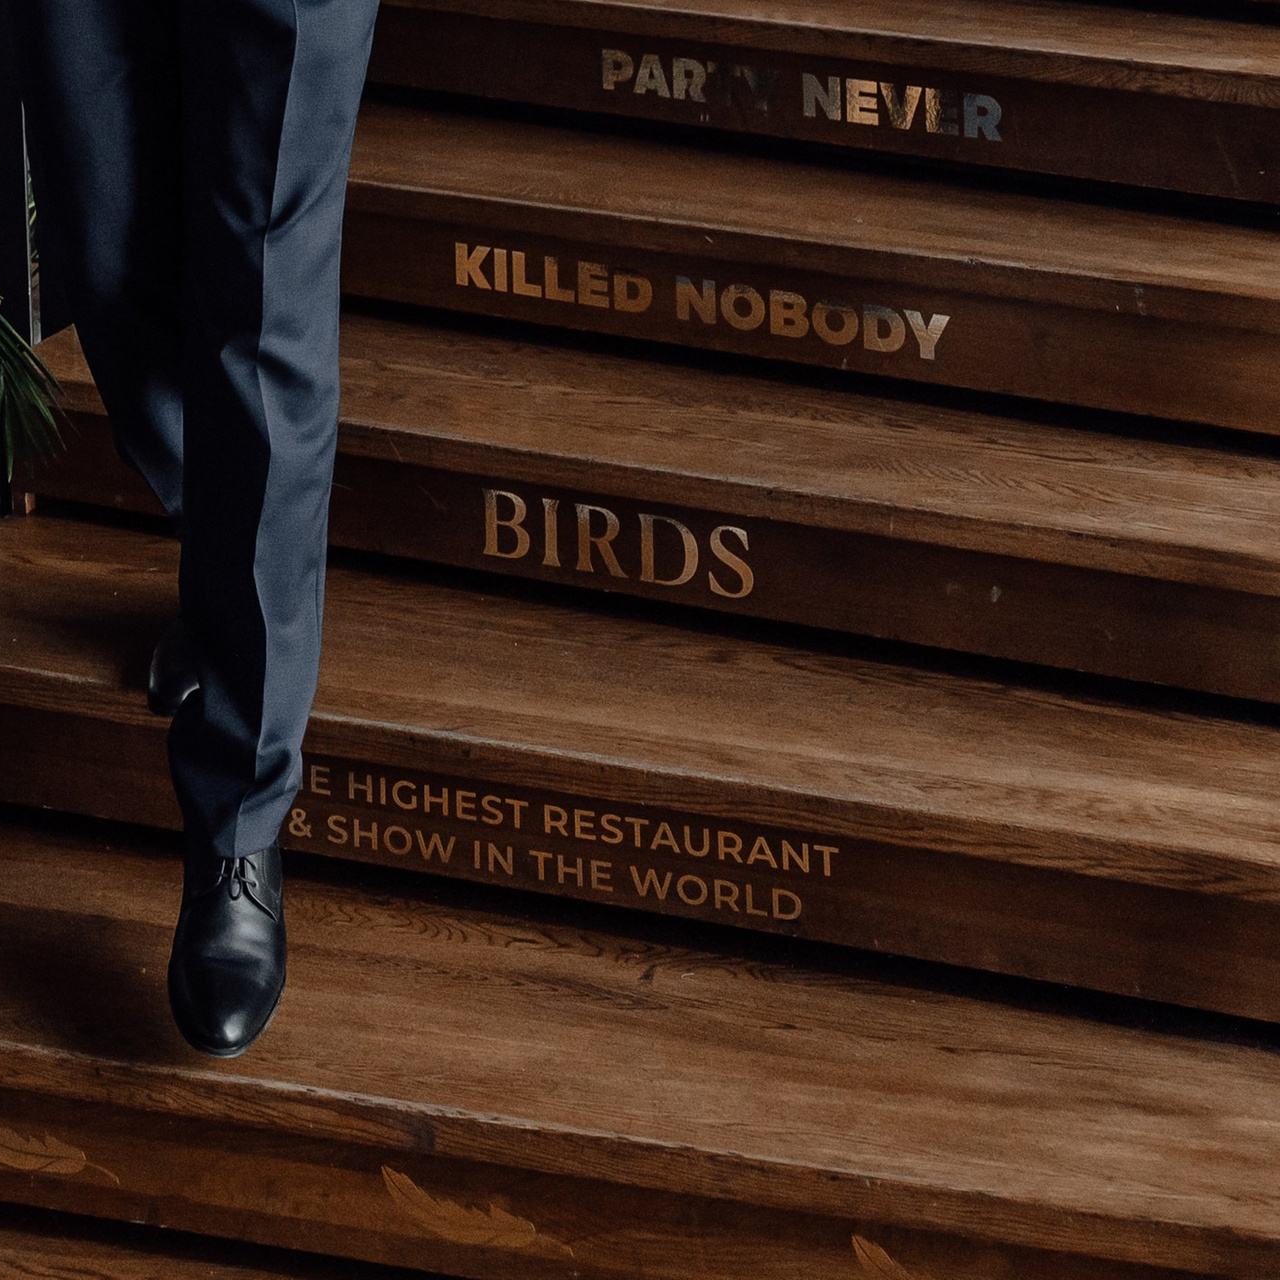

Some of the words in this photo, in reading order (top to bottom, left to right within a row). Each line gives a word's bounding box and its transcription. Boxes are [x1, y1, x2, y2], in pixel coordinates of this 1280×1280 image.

[801, 72, 1004, 142] NEVER
[454, 241, 654, 314] KILLED
[674, 274, 952, 361] NOBODY
[481, 486, 756, 600] BIRDS
[287, 807, 313, 839] &
[325, 813, 457, 865] SHOW
[472, 840, 516, 877] IN
[528, 848, 615, 893] THE
[627, 863, 804, 922] WORLD
[347, 770, 530, 829] HIGHEST
[542, 802, 841, 878] RESTAURANT
